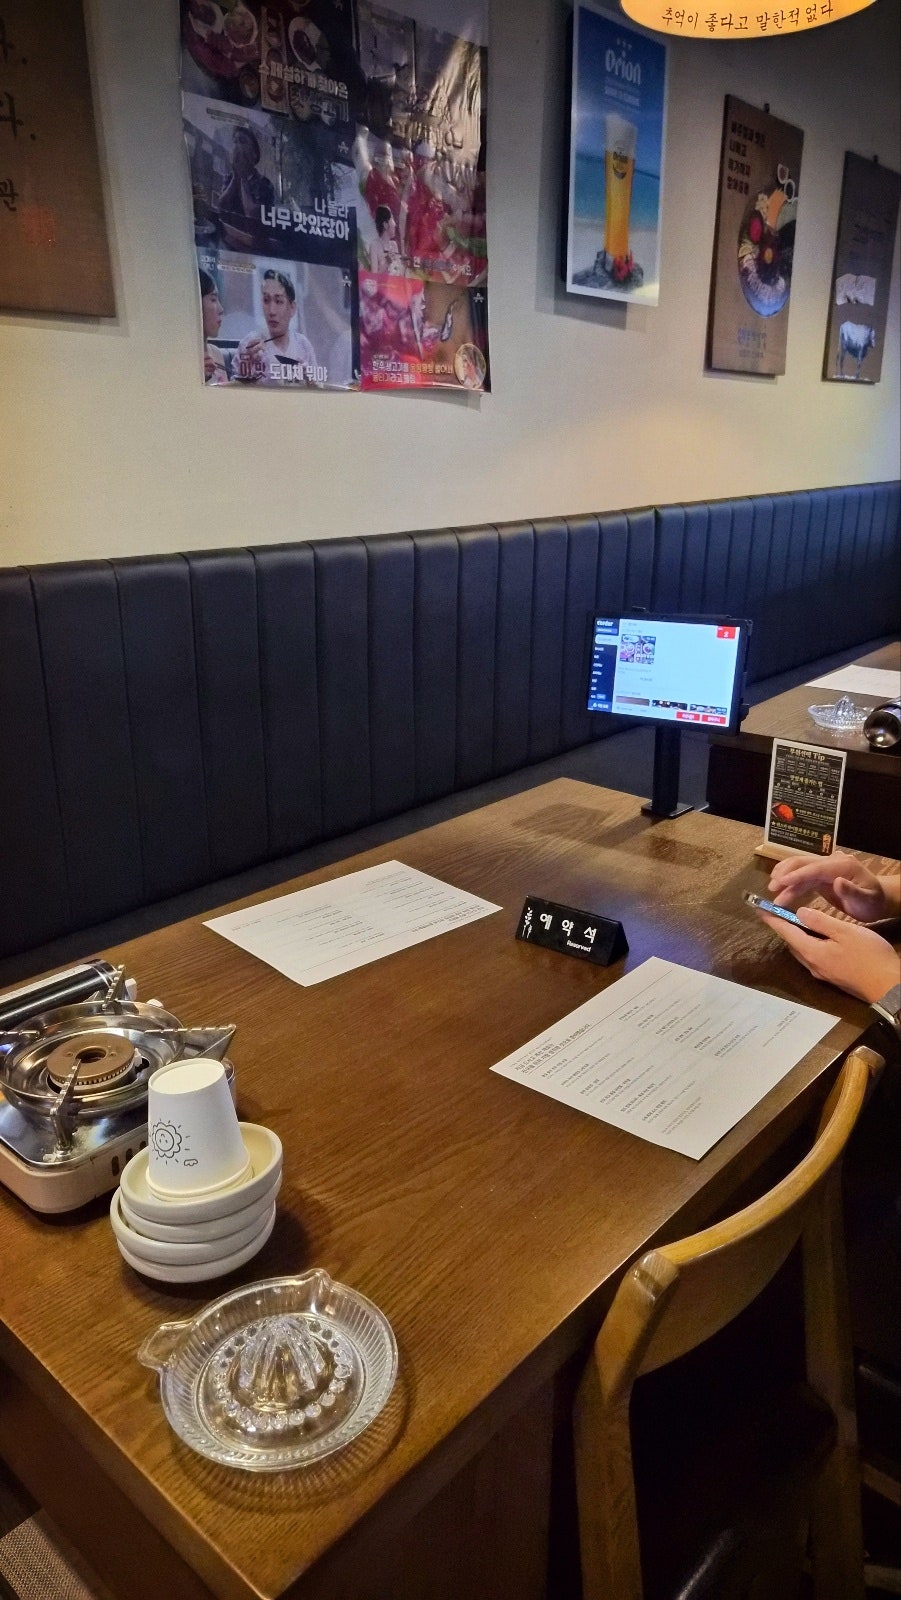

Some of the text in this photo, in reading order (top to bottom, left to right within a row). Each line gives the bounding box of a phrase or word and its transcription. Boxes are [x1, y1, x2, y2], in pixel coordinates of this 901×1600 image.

[661, 0, 834, 33] 추억이 좋다고 말한적 없다
[605, 49, 642, 86] Orion
[260, 204, 350, 241] 너무 맛있잖아
[270, 363, 304, 381] 도대체
[305, 365, 328, 382] 뭐야
[812, 752, 826, 762] Tip
[539, 913, 598, 944] 예약석
[566, 939, 592, 953] Reserved
